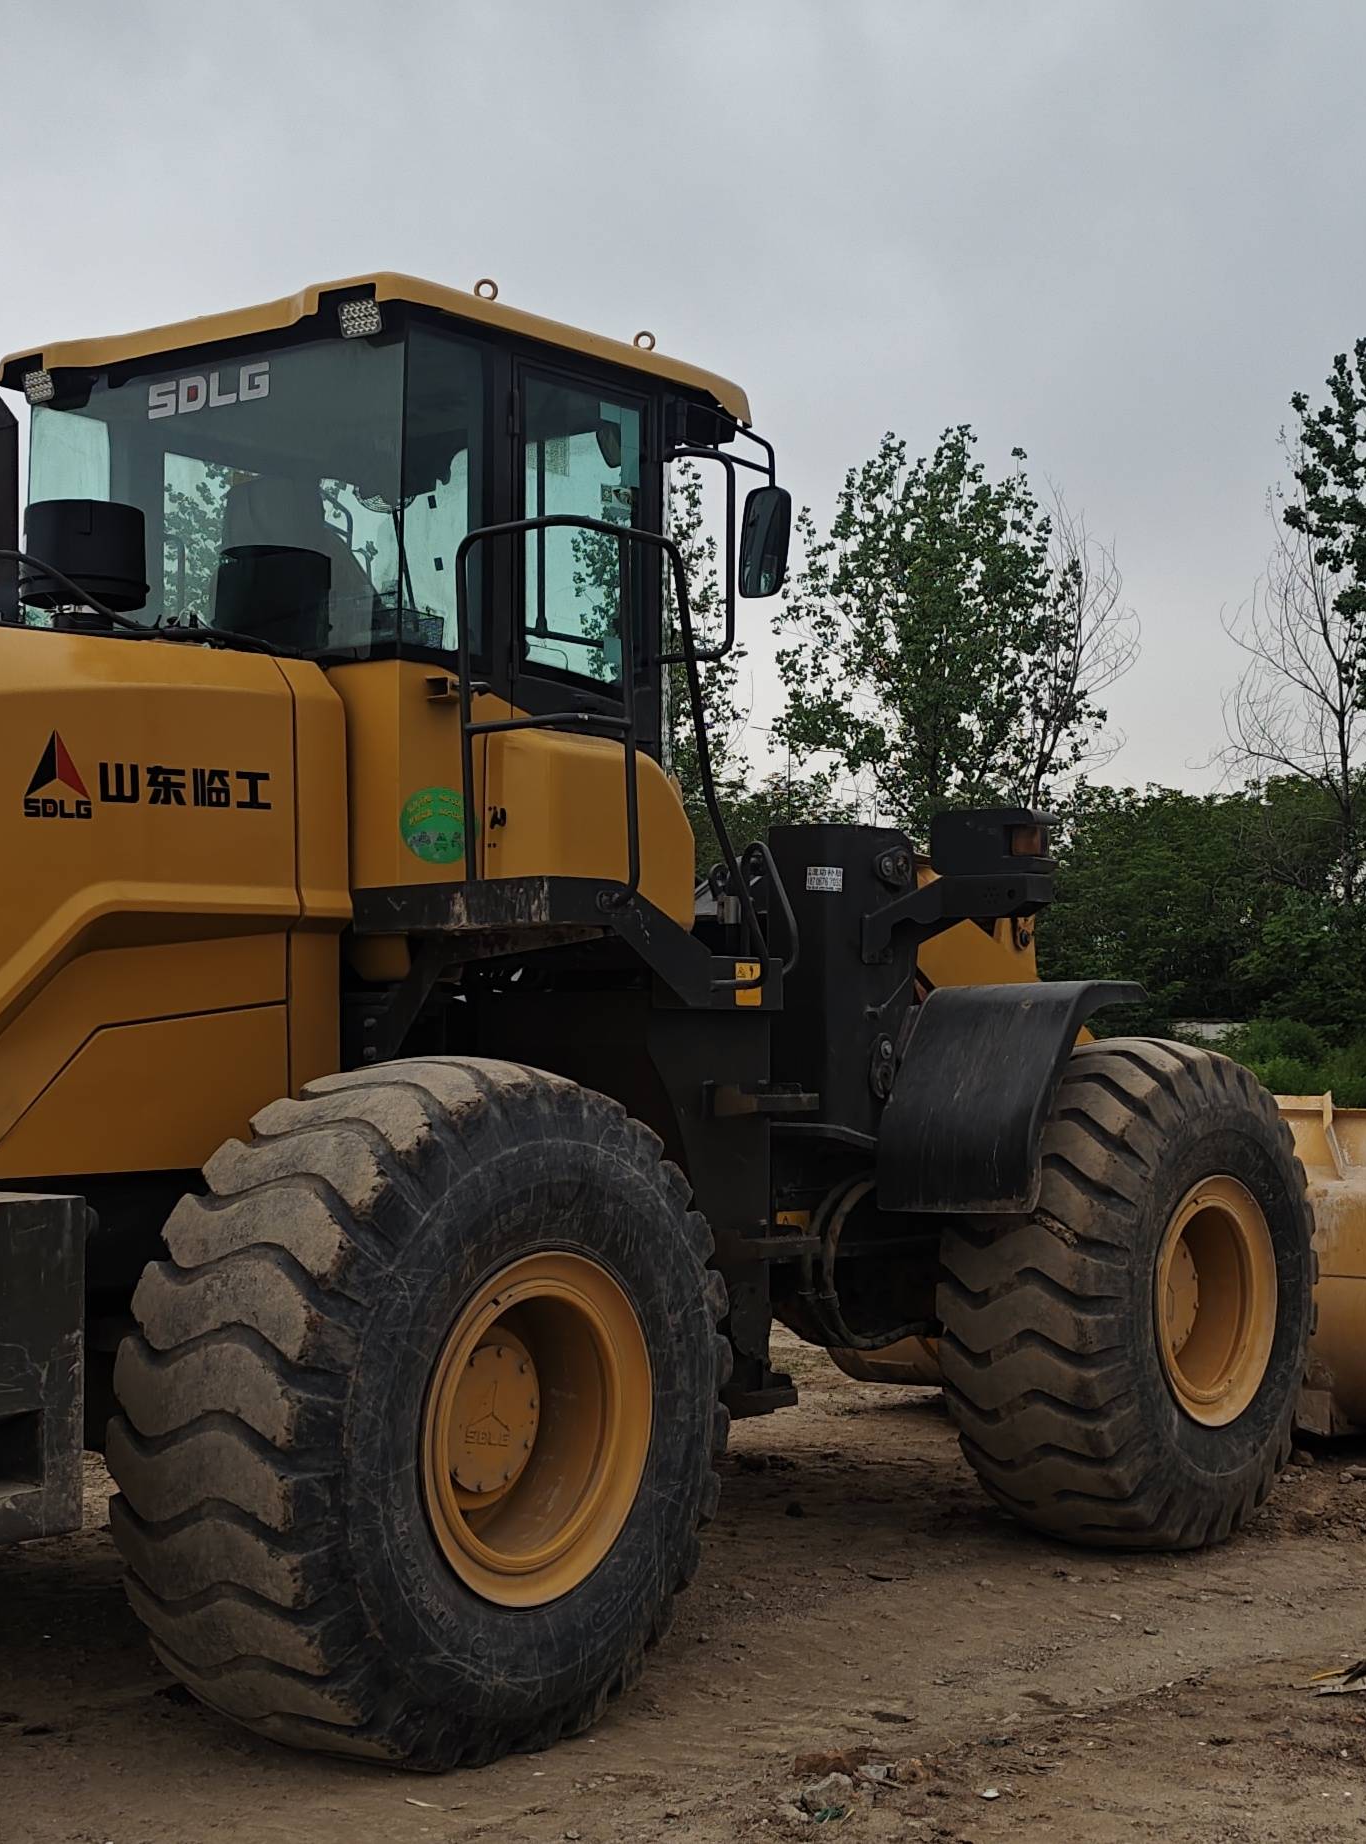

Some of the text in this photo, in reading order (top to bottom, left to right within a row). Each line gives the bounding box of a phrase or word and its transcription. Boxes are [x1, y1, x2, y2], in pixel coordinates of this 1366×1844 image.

[148, 361, 270, 420] SDLG
[24, 798, 92, 819] SDLG
[99, 762, 273, 810] 山东临工
